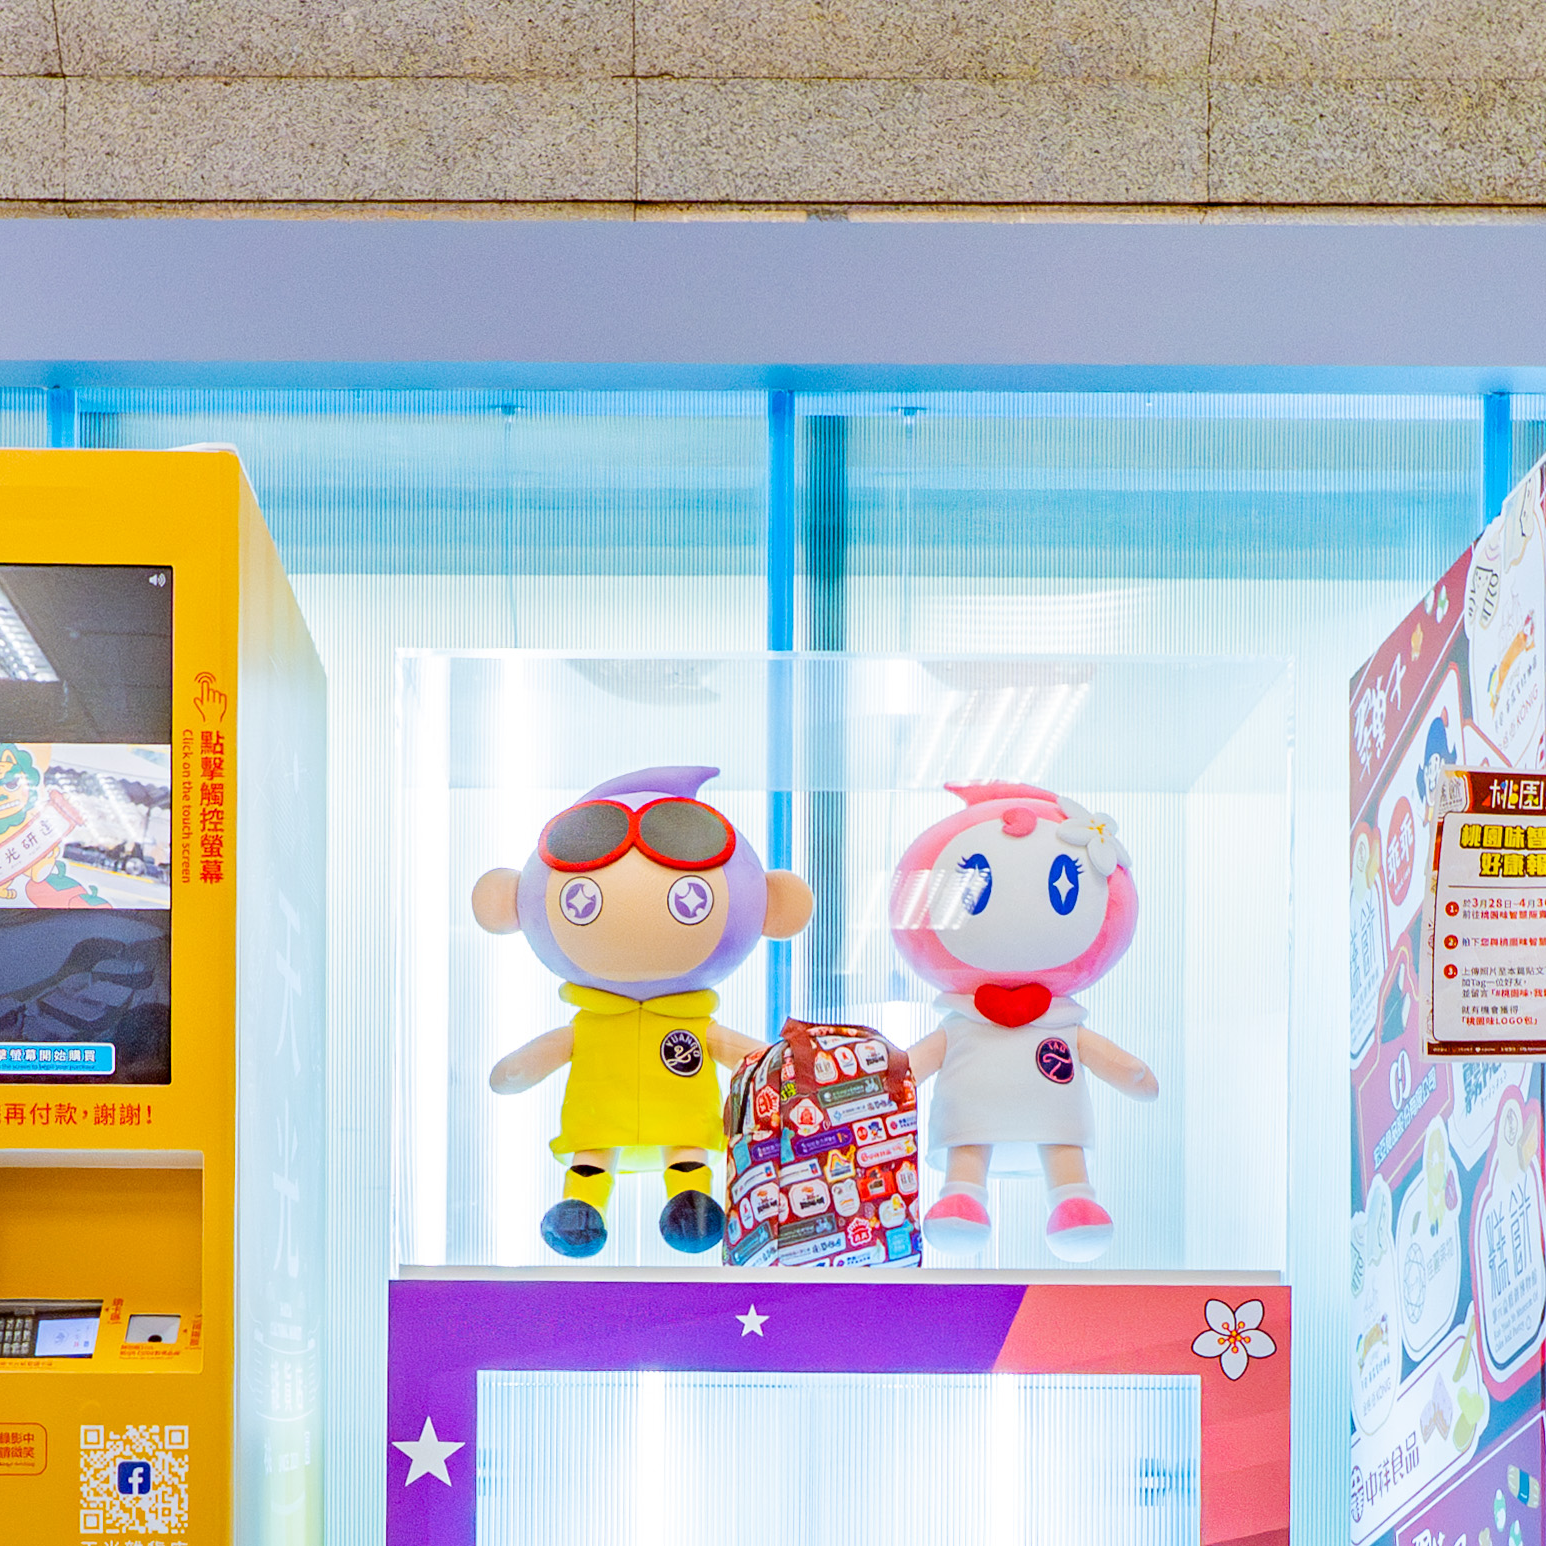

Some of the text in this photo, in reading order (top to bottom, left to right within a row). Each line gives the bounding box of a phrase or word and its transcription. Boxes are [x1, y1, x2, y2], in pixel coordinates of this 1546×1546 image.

[181, 729, 193, 884] Click on the touch screen
[198, 729, 226, 885] 點擊觸控螢幕
[1387, 812, 1414, 884] 乖乖
[0, 1431, 35, 1444] 錄影中
[1365, 1431, 1420, 1505] 中祥食品
